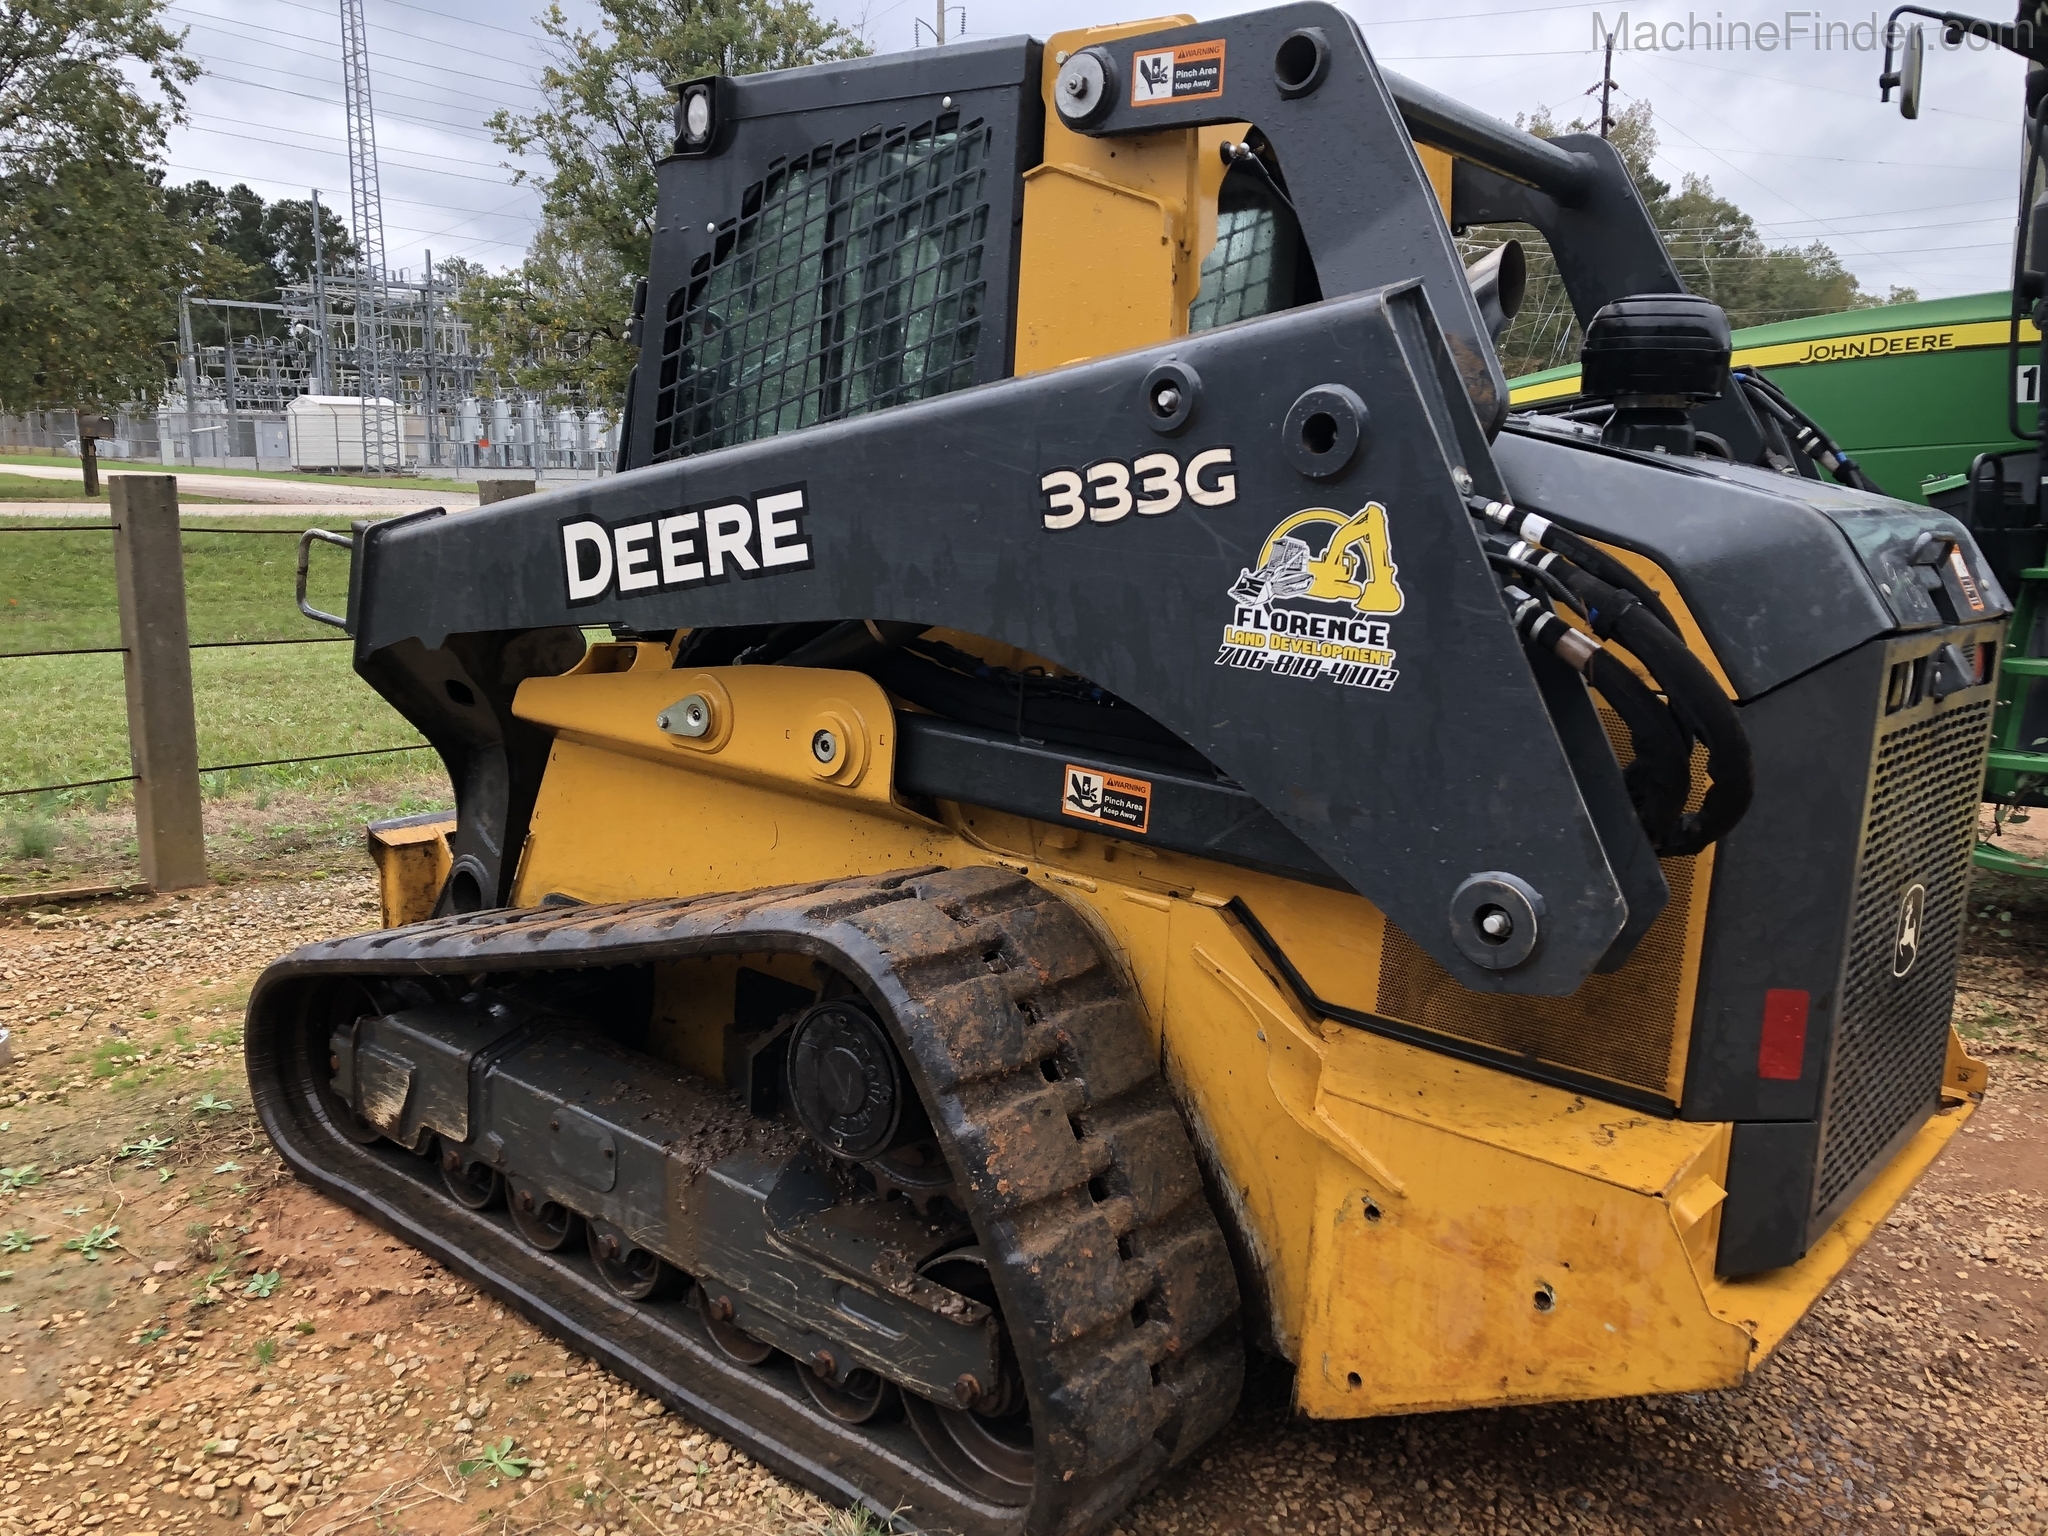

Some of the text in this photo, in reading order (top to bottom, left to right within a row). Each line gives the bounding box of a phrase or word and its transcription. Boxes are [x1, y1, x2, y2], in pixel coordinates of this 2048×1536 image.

[1185, 46, 1220, 57] WARNING
[1175, 67, 1218, 78] Pinch Area
[1175, 79, 1211, 90] Keep Away
[1041, 448, 1237, 529] 333G
[562, 489, 809, 601] DEERE
[1236, 607, 1387, 647] FLORENCE
[1225, 627, 1393, 667] LAND DEVELOPMENT
[1217, 646, 1397, 689] 706-818-4102
[1114, 780, 1146, 793] WARNING
[1104, 795, 1143, 812] Pinch Area
[1104, 806, 1136, 821] Keep Away
